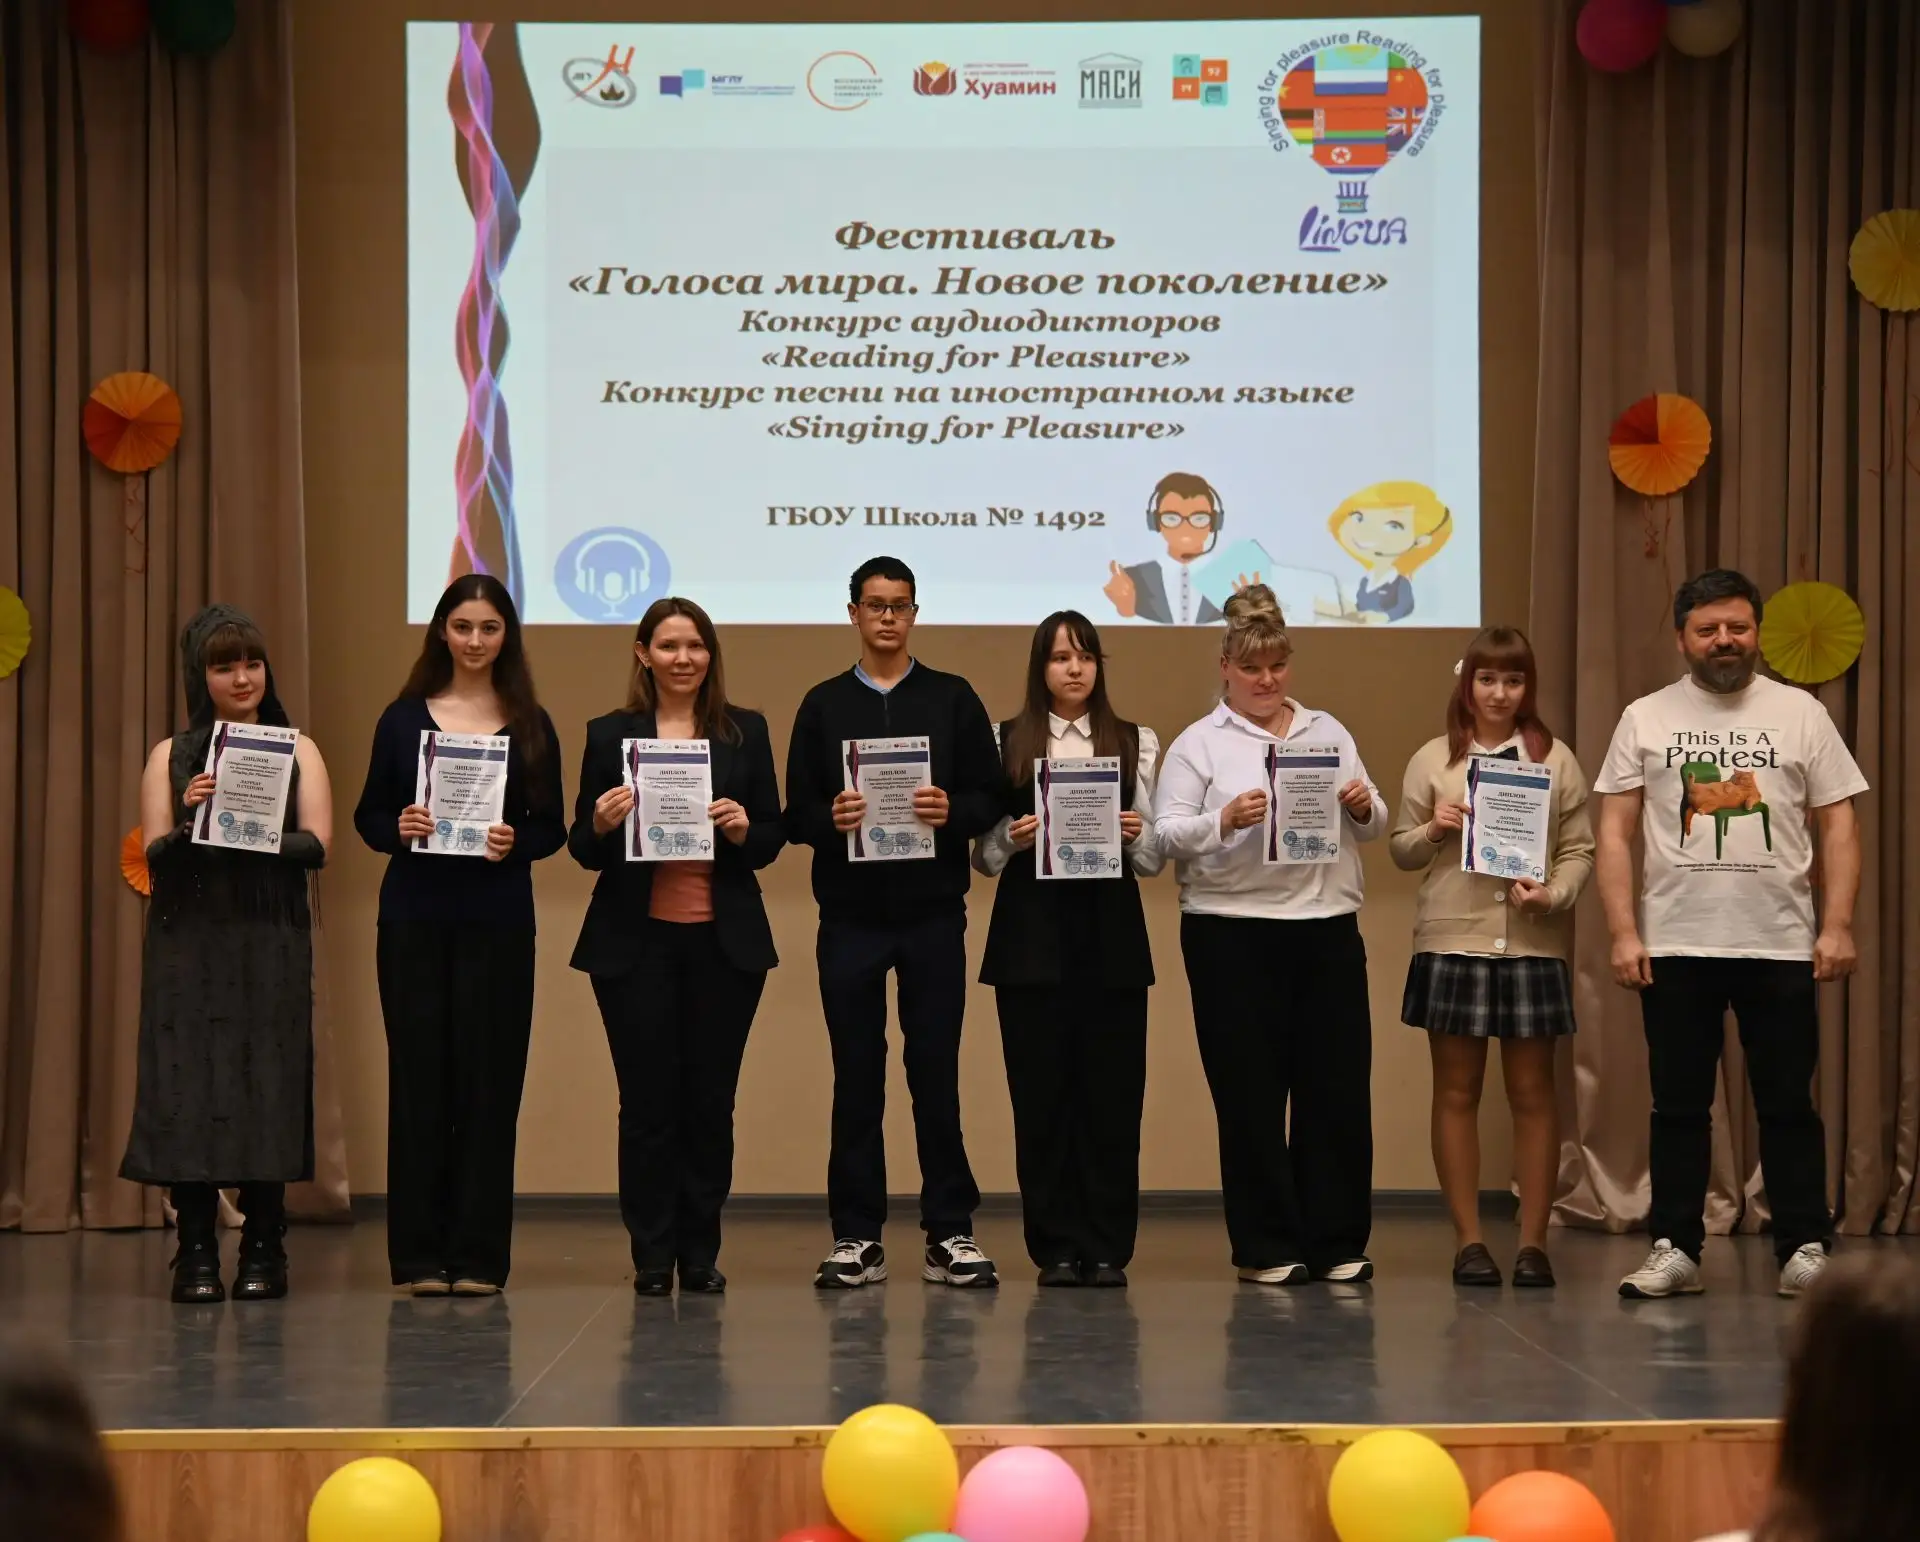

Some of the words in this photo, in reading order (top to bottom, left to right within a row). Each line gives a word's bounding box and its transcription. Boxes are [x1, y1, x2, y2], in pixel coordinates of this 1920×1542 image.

[1276, 31, 1350, 72] pleasure
[1356, 29, 1428, 69] Reading
[964, 79, 1056, 100] Хуамин
[1081, 69, 1141, 99] МАСИ
[1257, 69, 1279, 93] for
[1425, 67, 1443, 89] for
[1257, 95, 1290, 153] Singing
[1407, 92, 1447, 158] pleasure
[835, 221, 1116, 250] Фестиваль
[568, 266, 764, 296] «Голоса
[774, 273, 919, 302] мира.
[932, 266, 1084, 295] Новое
[1097, 271, 1389, 295] поколение»
[738, 309, 902, 338] Конкурс
[911, 308, 1221, 338] аудиодикторов
[761, 345, 934, 373] «Reading
[936, 345, 998, 373] for
[1007, 344, 1191, 369] Pleasure»
[600, 380, 765, 409] Конкурс
[773, 385, 884, 403] песни
[894, 385, 939, 403] на
[950, 385, 1225, 409] иностранном
[1234, 385, 1355, 403] языке
[767, 415, 929, 445] «Singing
[930, 415, 994, 445] for
[1001, 415, 1186, 439] Pleasure»
[766, 506, 856, 527] ГБОУ
[863, 506, 979, 527] Школа
[986, 507, 1025, 527] №
[1034, 508, 1106, 531] 1492
[1672, 731, 1720, 746] This
[1729, 731, 1748, 745] Is
[1756, 732, 1771, 746] A
[1665, 747, 1780, 769] Protest
